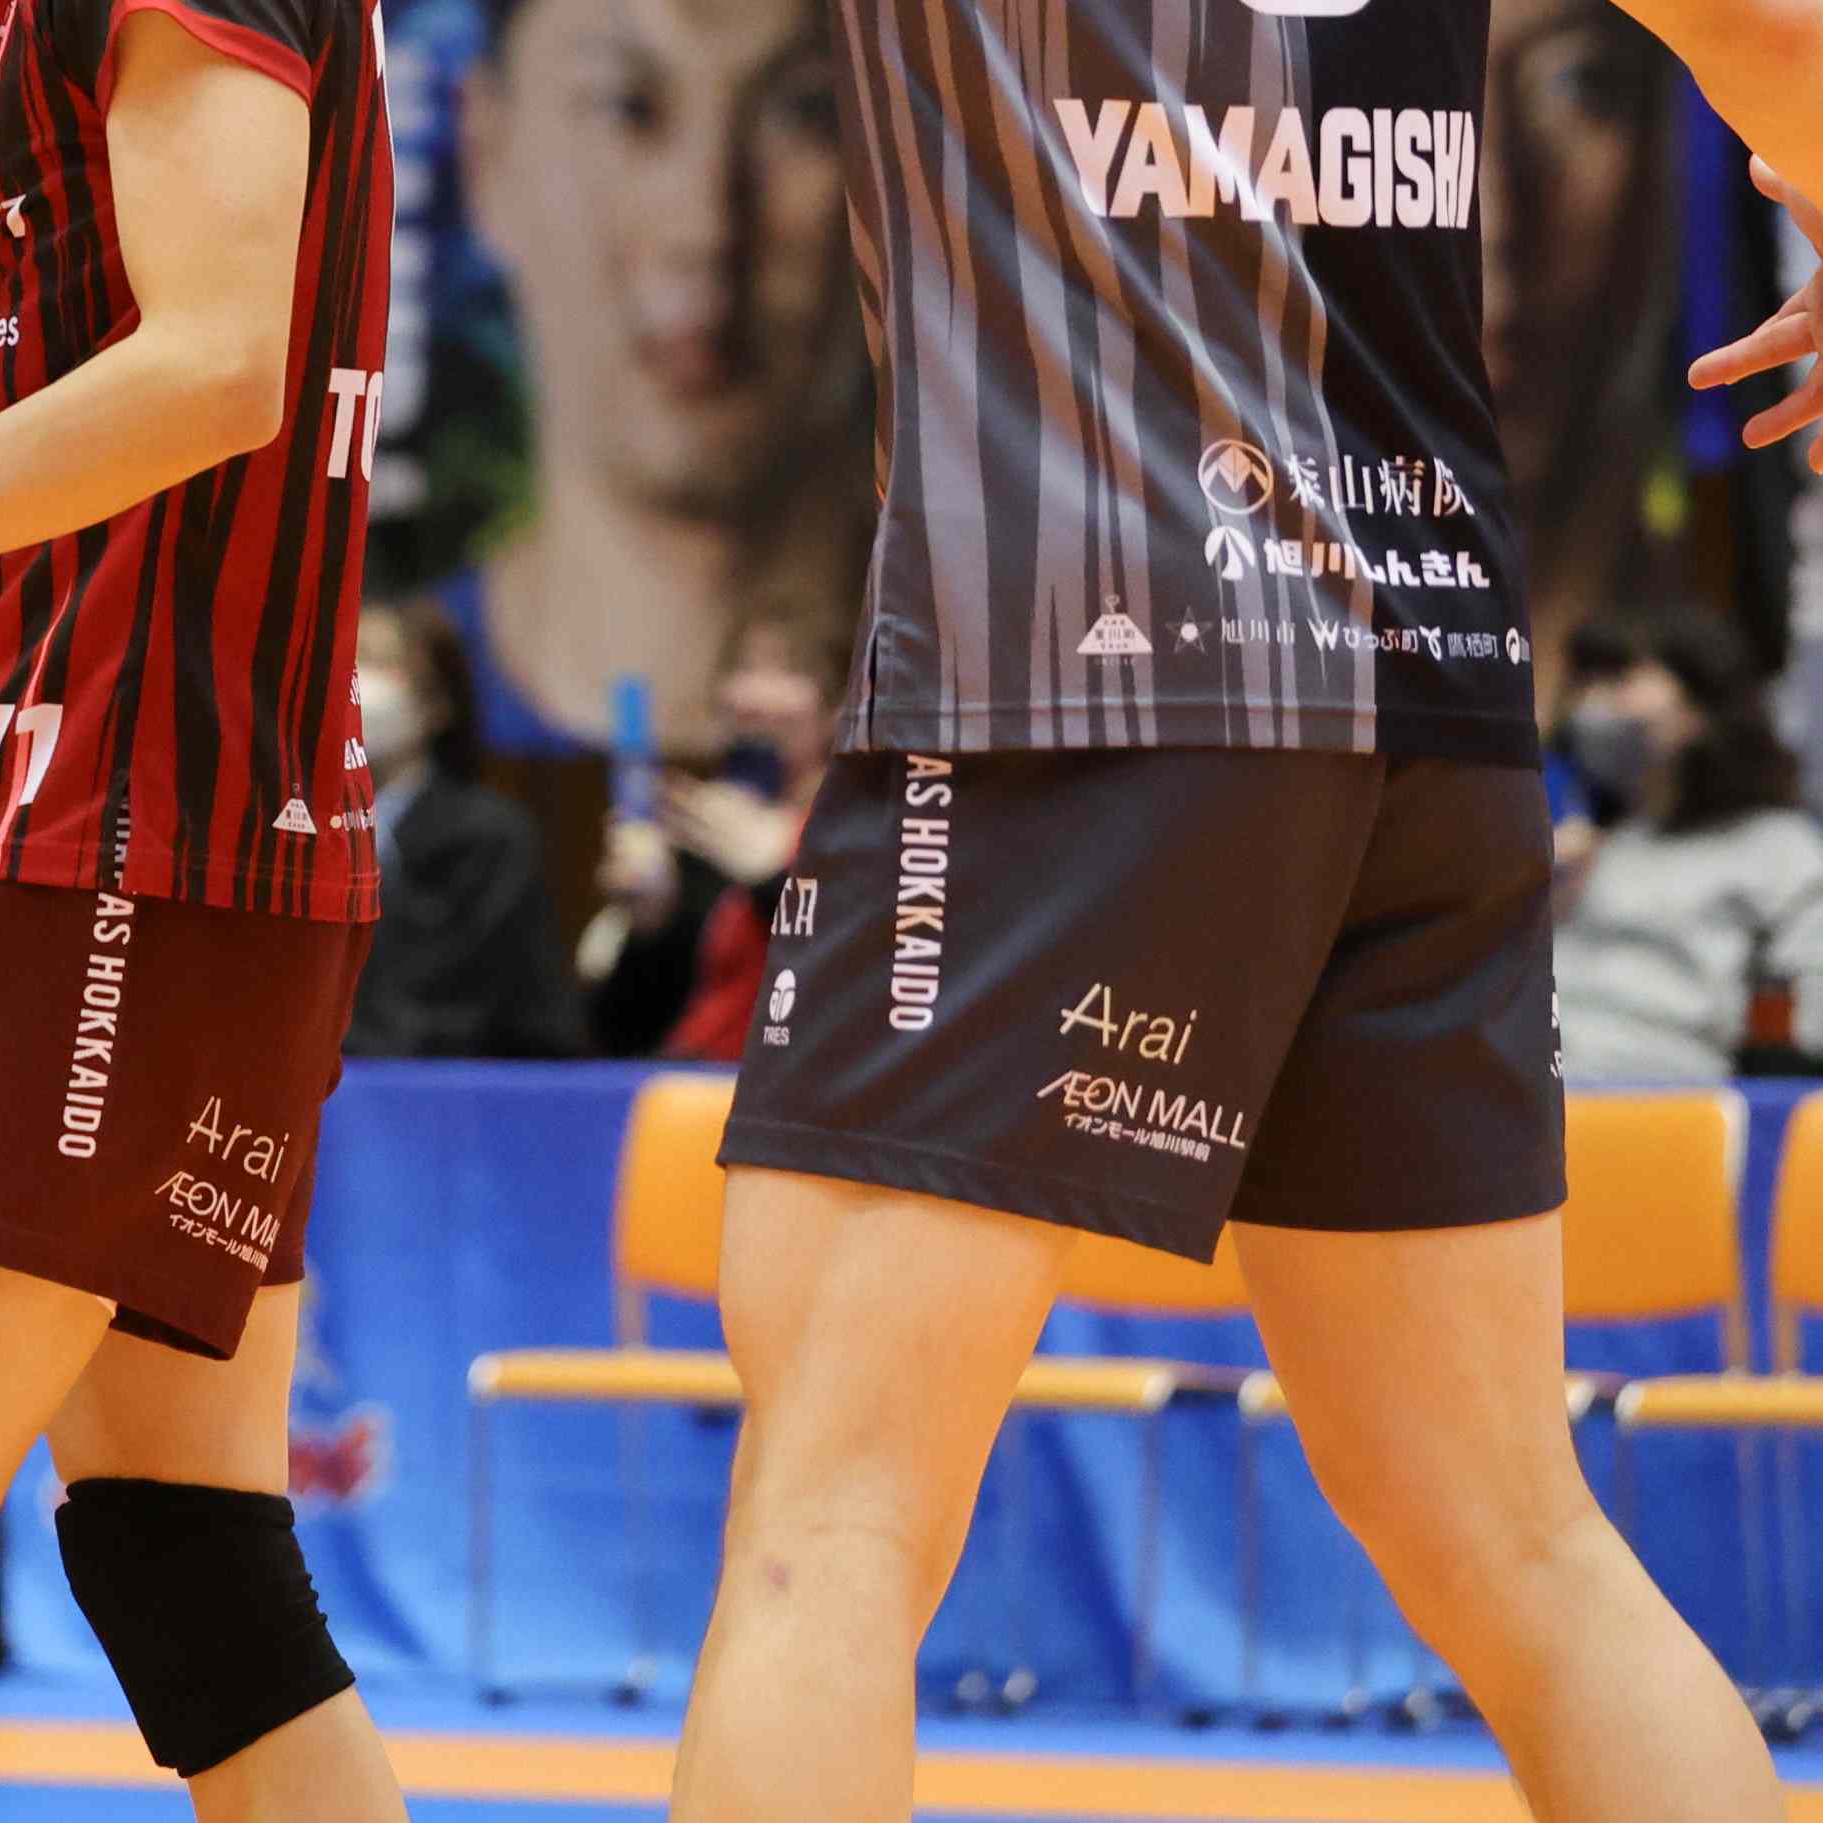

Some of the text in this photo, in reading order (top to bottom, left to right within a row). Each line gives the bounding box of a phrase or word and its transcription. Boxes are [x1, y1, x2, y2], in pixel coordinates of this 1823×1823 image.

[889, 817, 950, 1032] HOKKAIDO
[58, 953, 126, 1159] HOKKAIDO
[1059, 982, 1198, 1065] Arai
[186, 1095, 289, 1184] Arai
[1146, 1088, 1246, 1149] MALL
